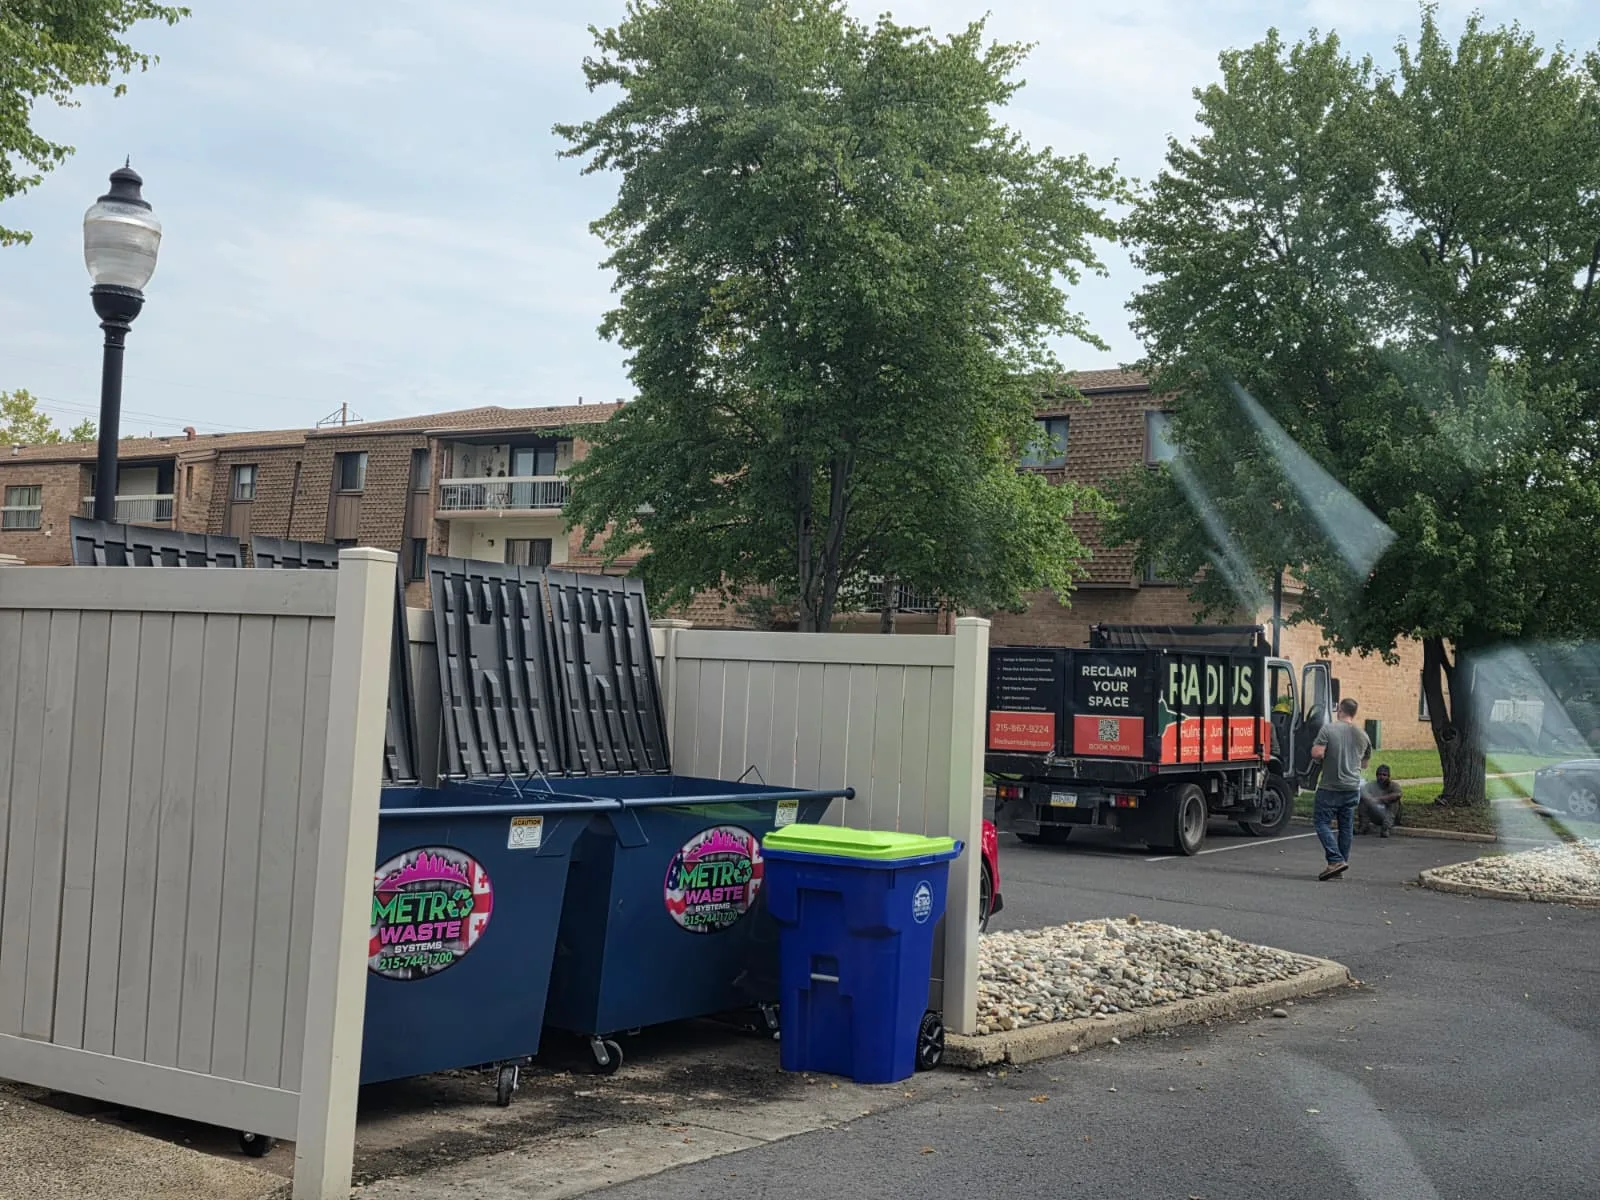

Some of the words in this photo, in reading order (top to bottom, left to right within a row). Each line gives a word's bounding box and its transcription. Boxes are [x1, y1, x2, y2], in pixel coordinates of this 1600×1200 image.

[1082, 665, 1137, 677] RECLAIM
[1093, 681, 1129, 692] YOUR
[1088, 696, 1129, 707] SPACE
[1088, 743, 1108, 751] BOOK
[679, 860, 752, 889] METRO
[685, 886, 744, 904] WASTE
[371, 889, 474, 926] METRO
[695, 903, 731, 912] SYSTEMS
[684, 910, 738, 926] 215-744-1700
[380, 921, 462, 944] WASTE
[394, 941, 442, 954] SYSTEMS
[379, 952, 453, 970] 215-744-1700
